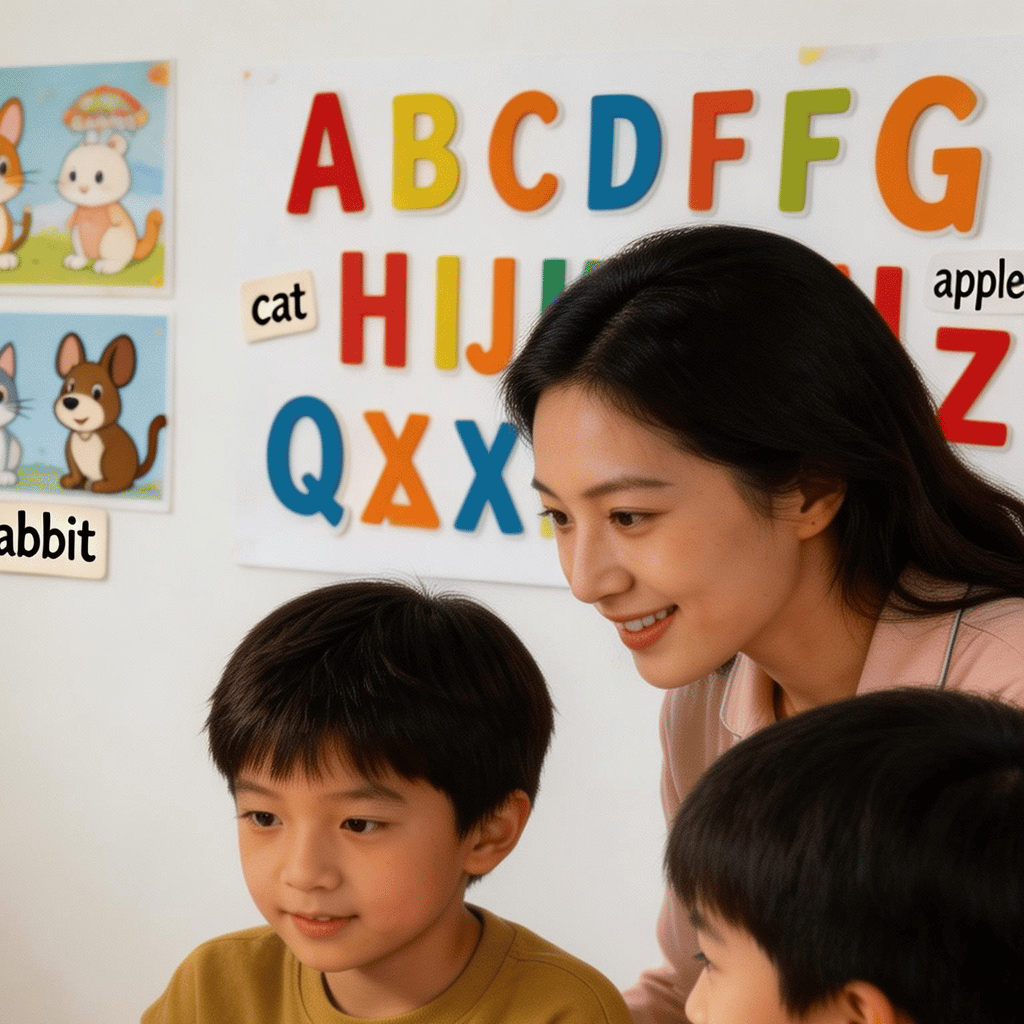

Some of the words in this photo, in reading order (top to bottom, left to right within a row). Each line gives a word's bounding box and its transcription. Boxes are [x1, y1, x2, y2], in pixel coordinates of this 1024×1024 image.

[251, 282, 308, 326] cat
[933, 257, 1024, 312] apple
[935, 326, 1011, 447] Z
